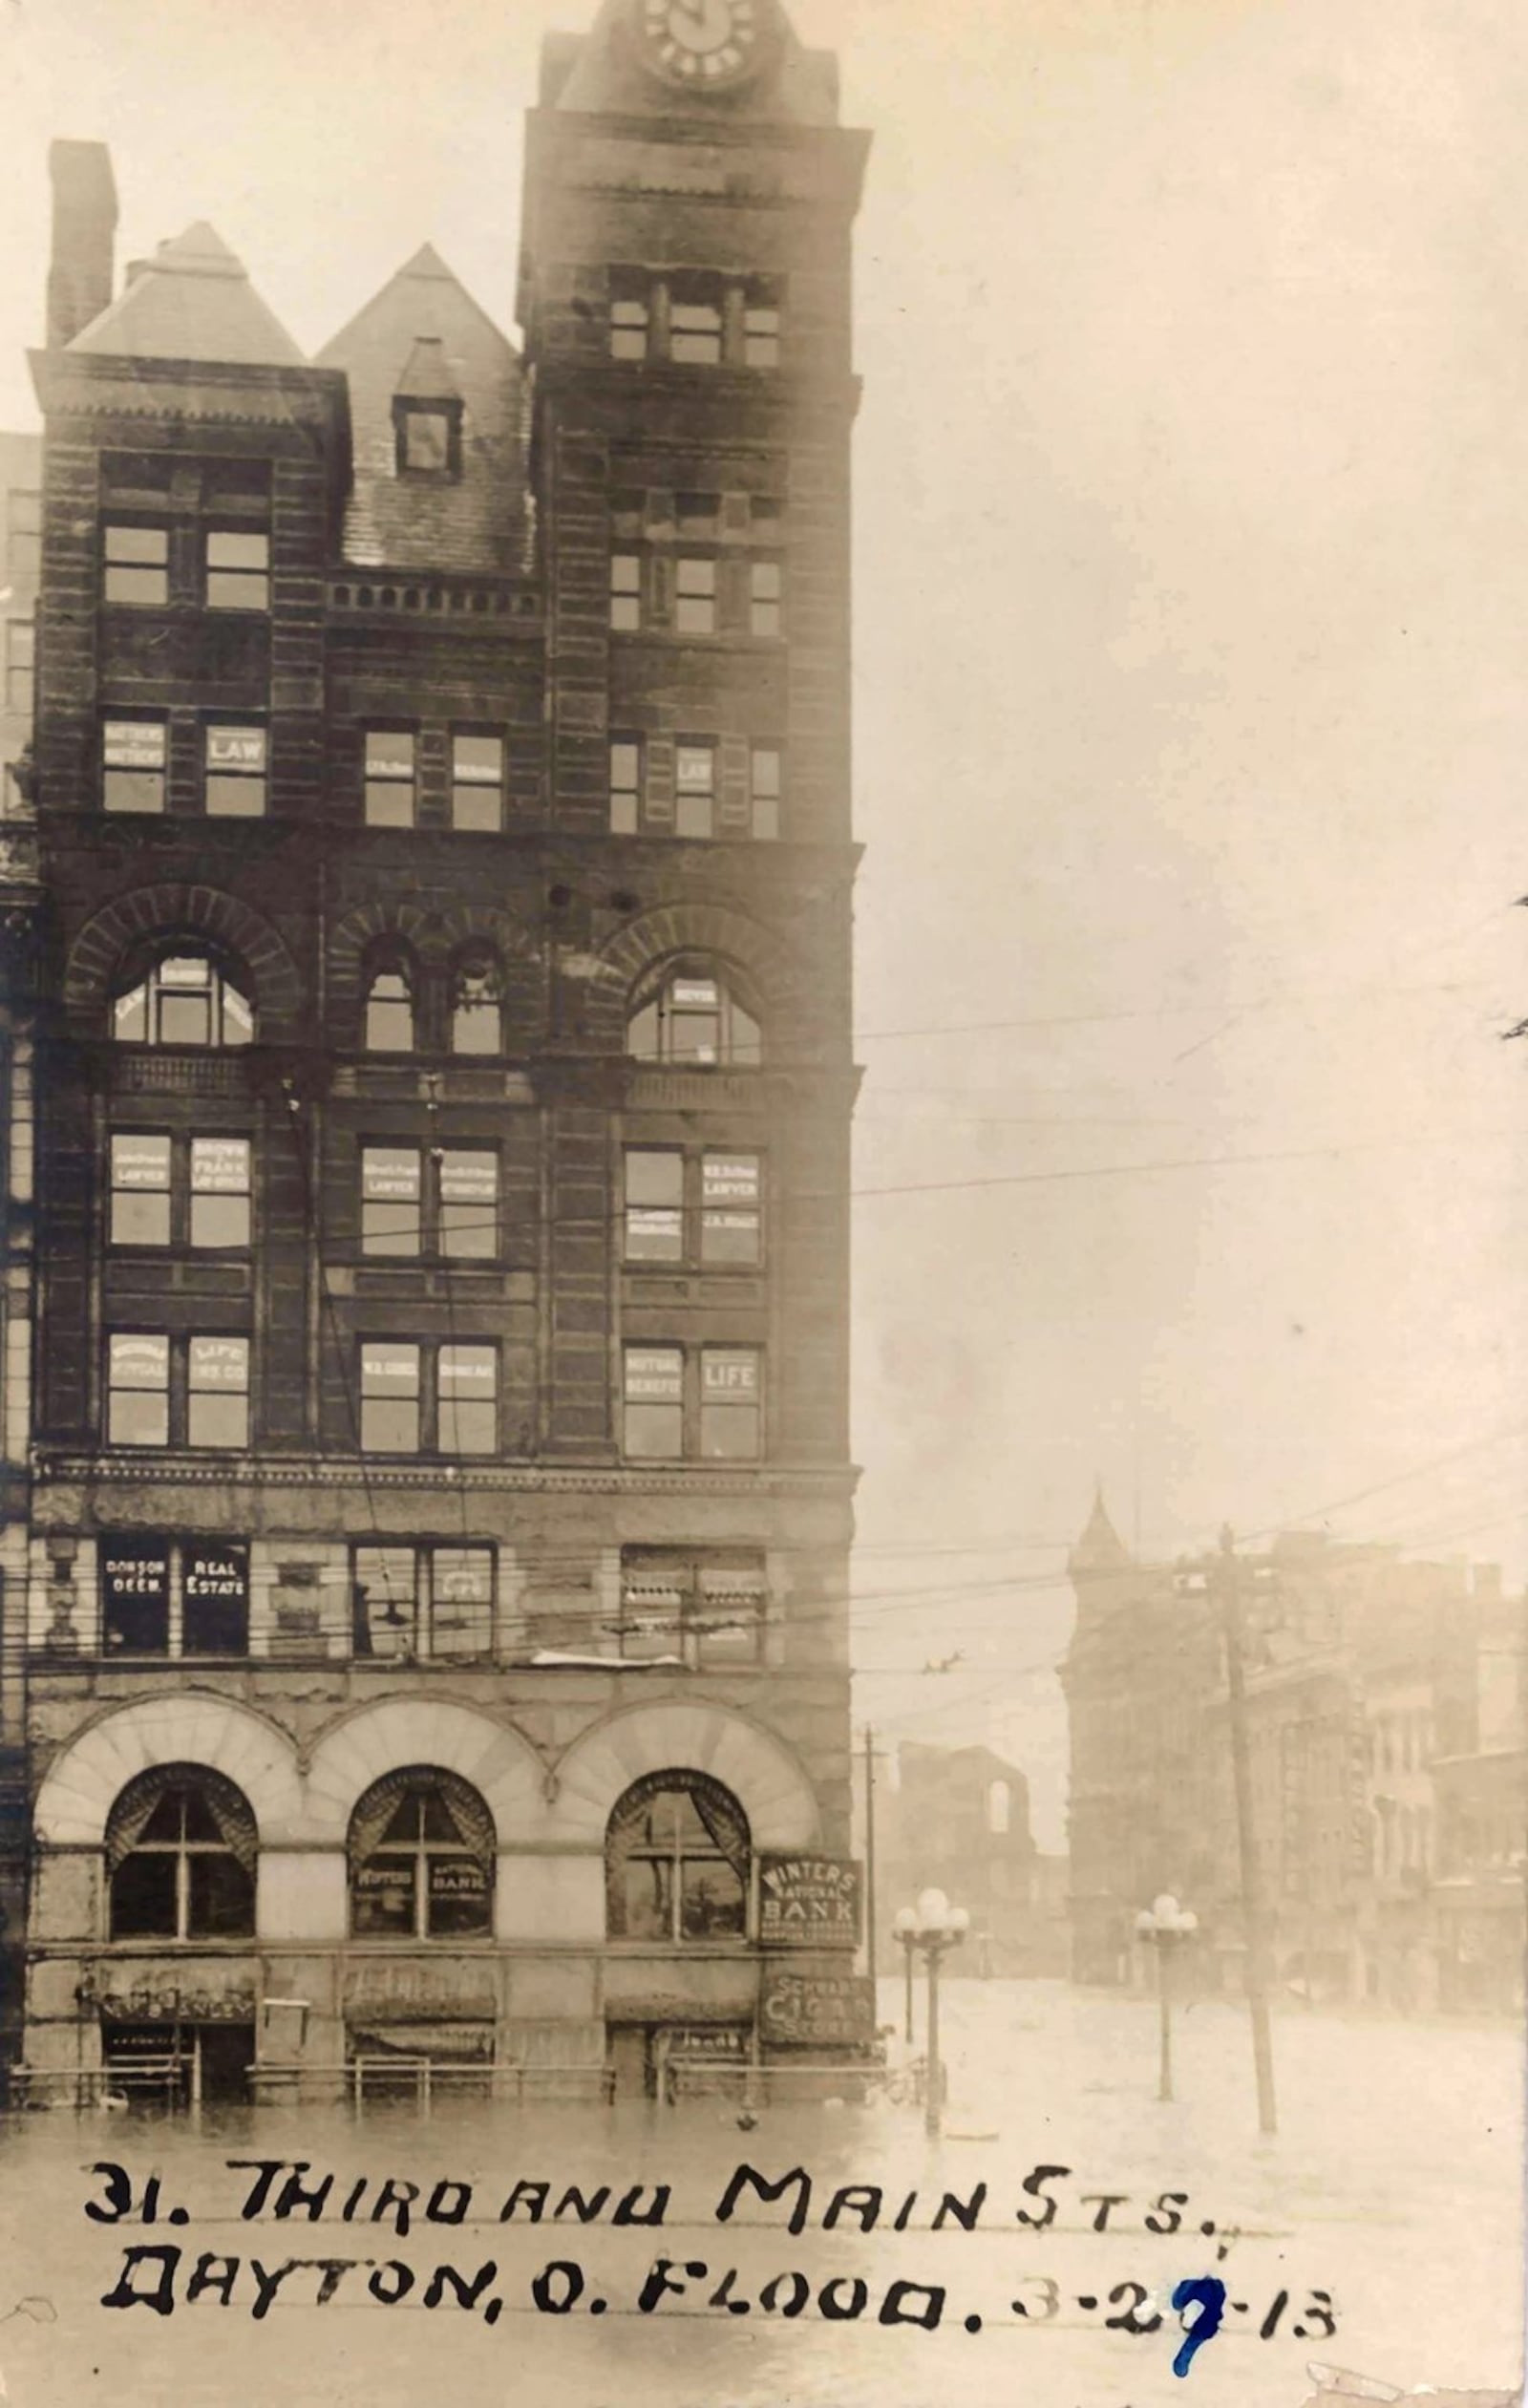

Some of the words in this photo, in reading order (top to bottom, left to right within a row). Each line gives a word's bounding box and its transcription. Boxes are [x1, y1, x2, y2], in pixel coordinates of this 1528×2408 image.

[210, 740, 262, 760] LAW
[704, 1366, 754, 1386] LIFE
[194, 1561, 237, 1576] REAL
[186, 1575, 244, 1595] ESTATE
[433, 1876, 485, 1890] BANK
[763, 1862, 856, 1891] WINTERS
[775, 1885, 848, 1900] NATIONAL
[764, 1900, 853, 1921] BANK
[766, 1995, 873, 2022] CIGAR
[785, 2017, 854, 2035] STORE
